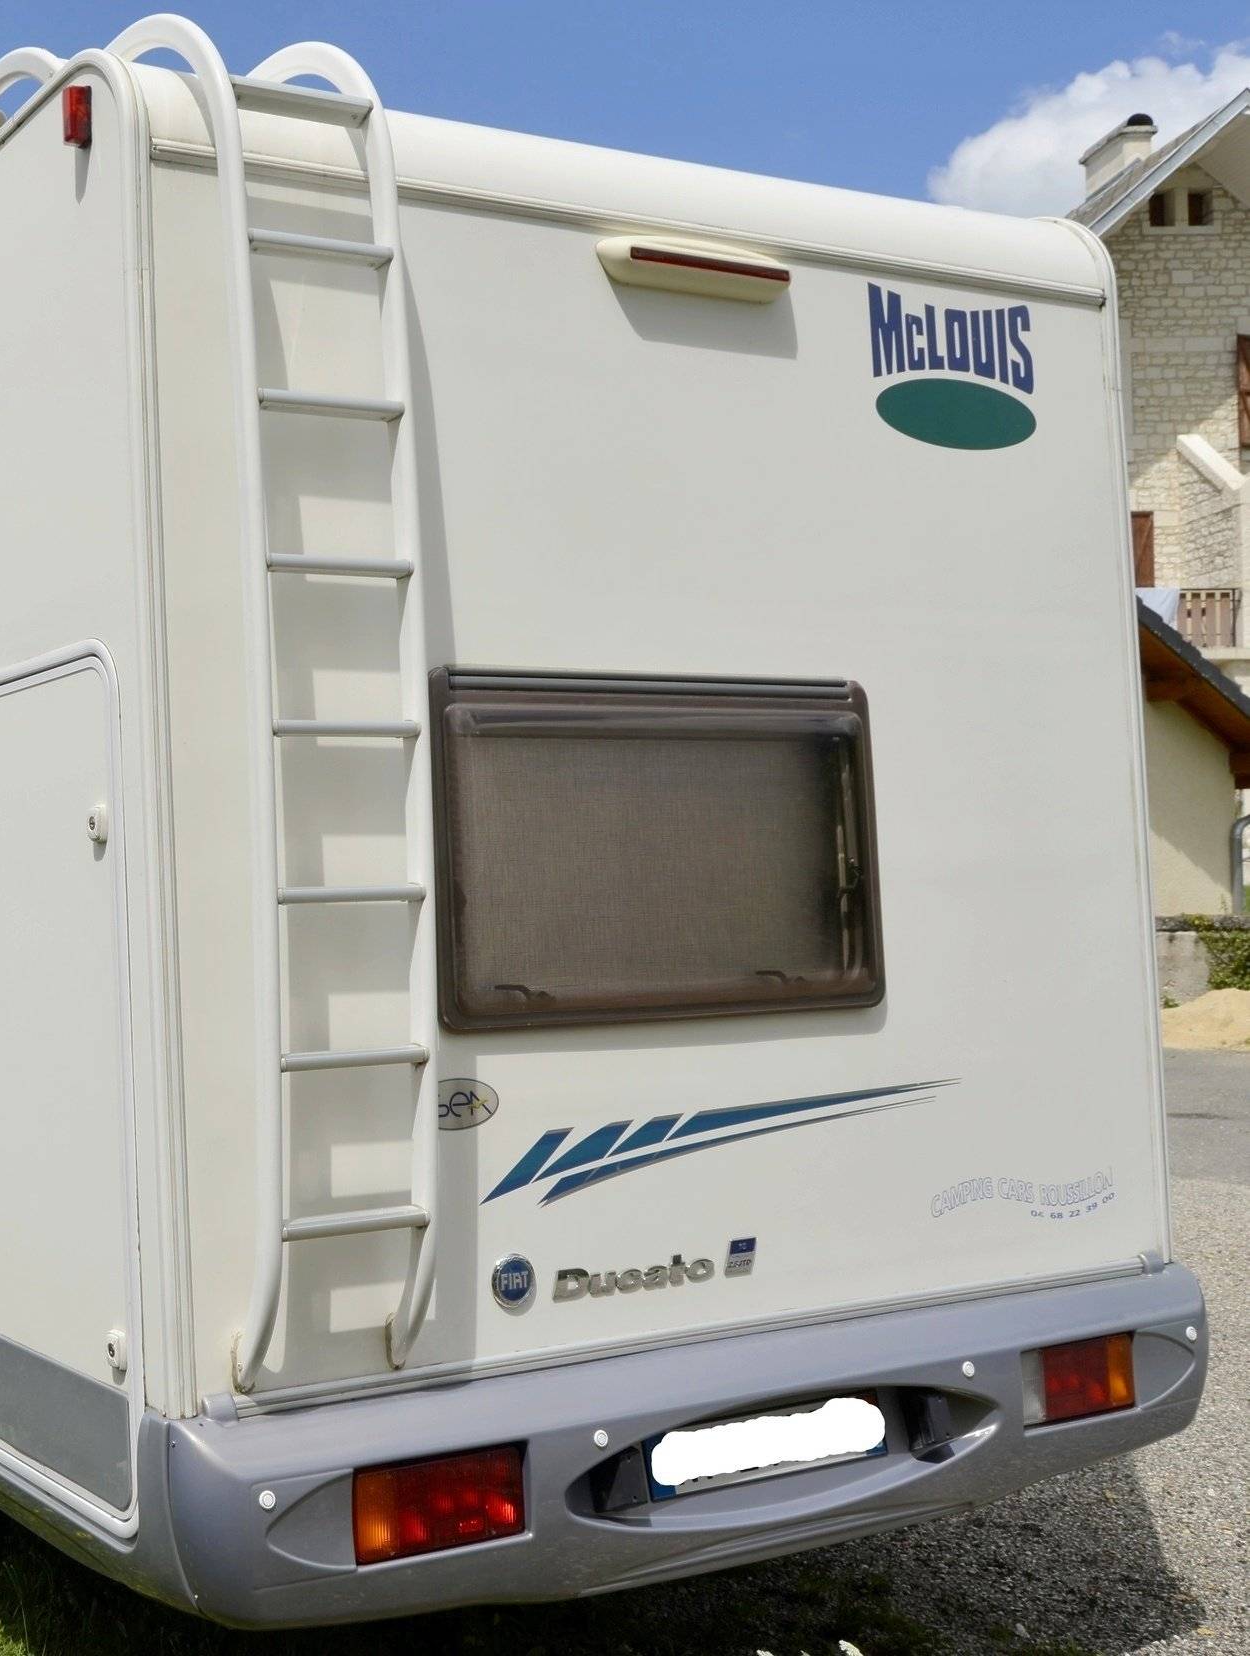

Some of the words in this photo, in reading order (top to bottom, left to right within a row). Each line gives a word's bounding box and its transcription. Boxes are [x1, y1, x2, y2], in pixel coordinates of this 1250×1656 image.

[867, 282, 1034, 395] McLOUIS
[931, 1176, 994, 1218] CAMPING
[998, 1177, 1035, 1203] CARS
[1069, 1209, 1081, 1218] 22
[1102, 1192, 1115, 1203] 00
[500, 1270, 529, 1292] FIAT
[552, 1254, 715, 1303] Ducato
